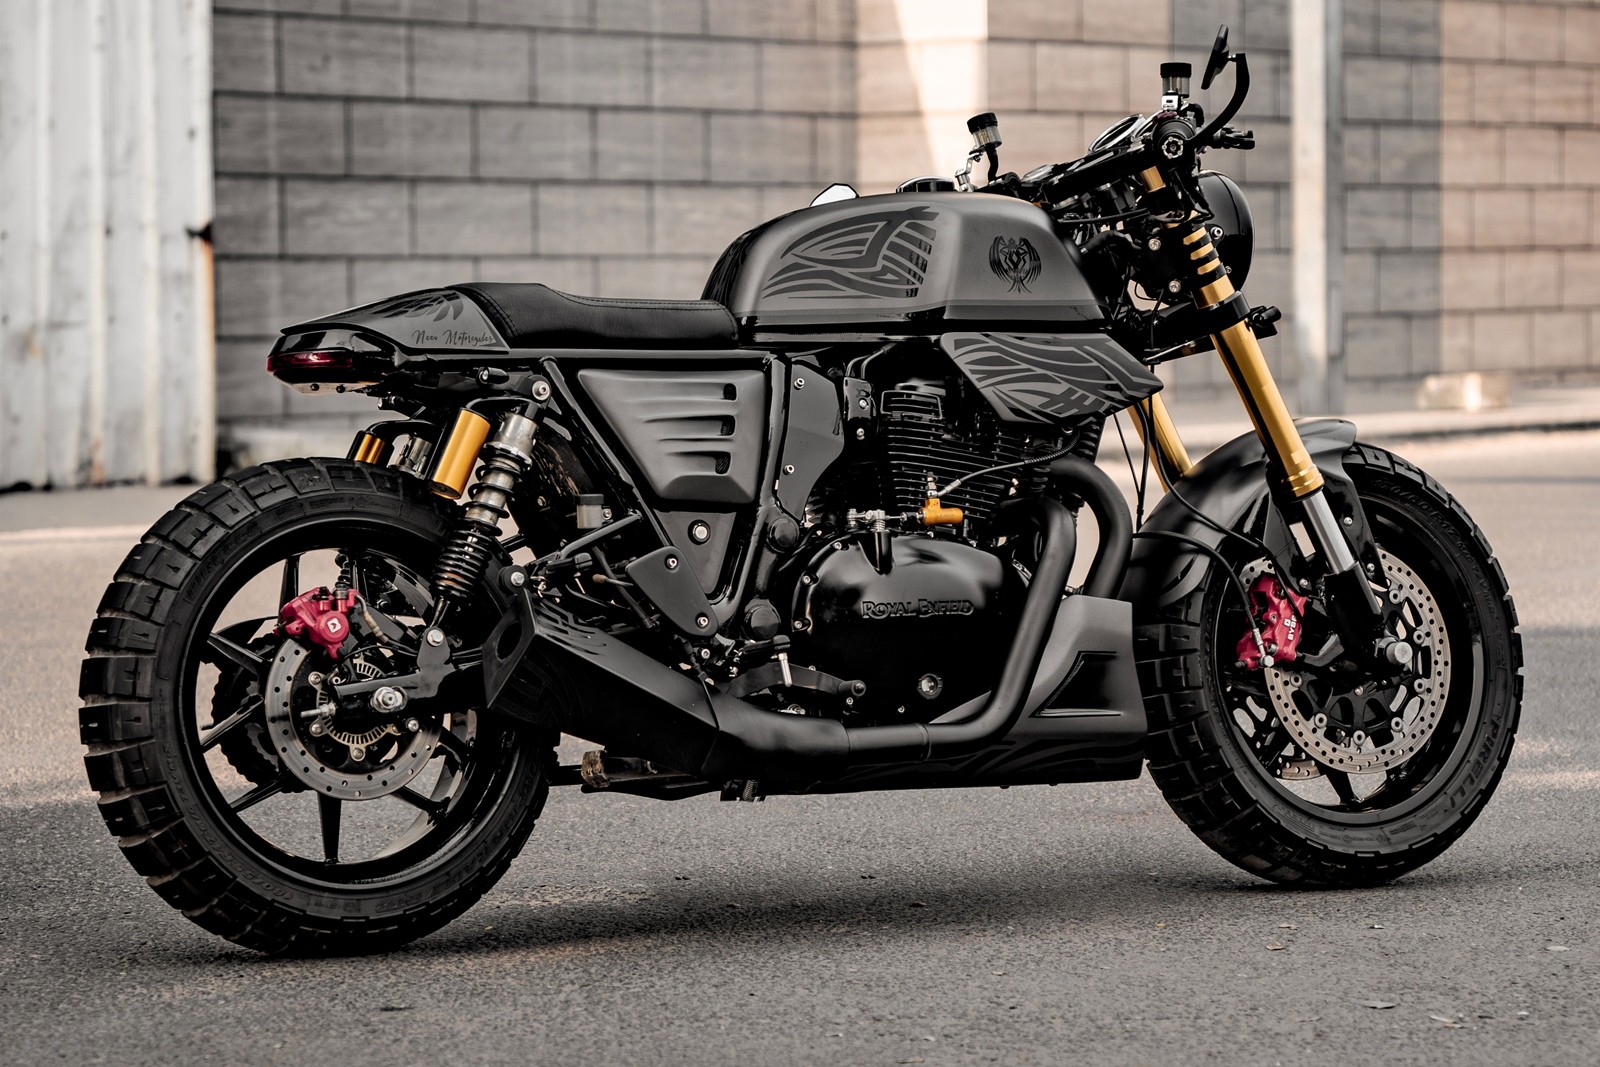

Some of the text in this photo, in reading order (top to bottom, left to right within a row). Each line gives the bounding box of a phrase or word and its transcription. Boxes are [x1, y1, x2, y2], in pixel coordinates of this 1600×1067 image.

[861, 599, 974, 619] ROYAL ENFIELD
[1446, 719, 1502, 808] PIRELLI
